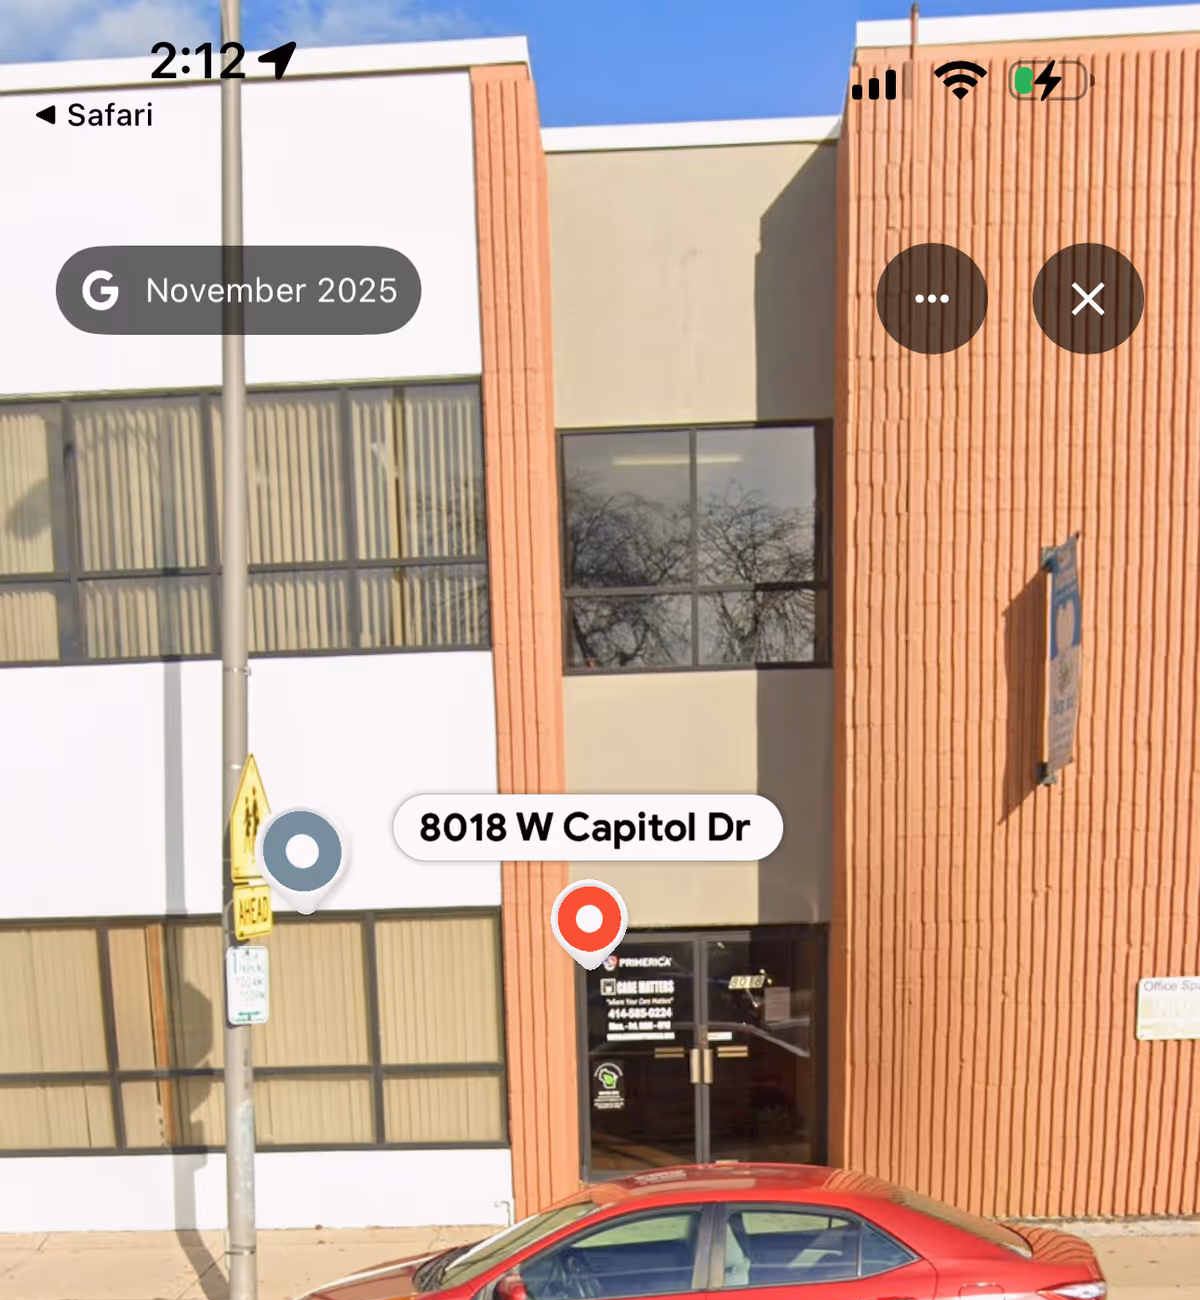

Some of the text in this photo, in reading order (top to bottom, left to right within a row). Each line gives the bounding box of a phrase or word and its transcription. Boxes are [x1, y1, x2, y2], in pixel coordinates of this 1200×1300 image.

[239, 896, 270, 926] AHEAD
[619, 956, 671, 968] PRIMERICA
[638, 980, 674, 994] MATTERS
[1144, 981, 1178, 992] Office
[607, 1007, 673, 1019] 414-585-0224
